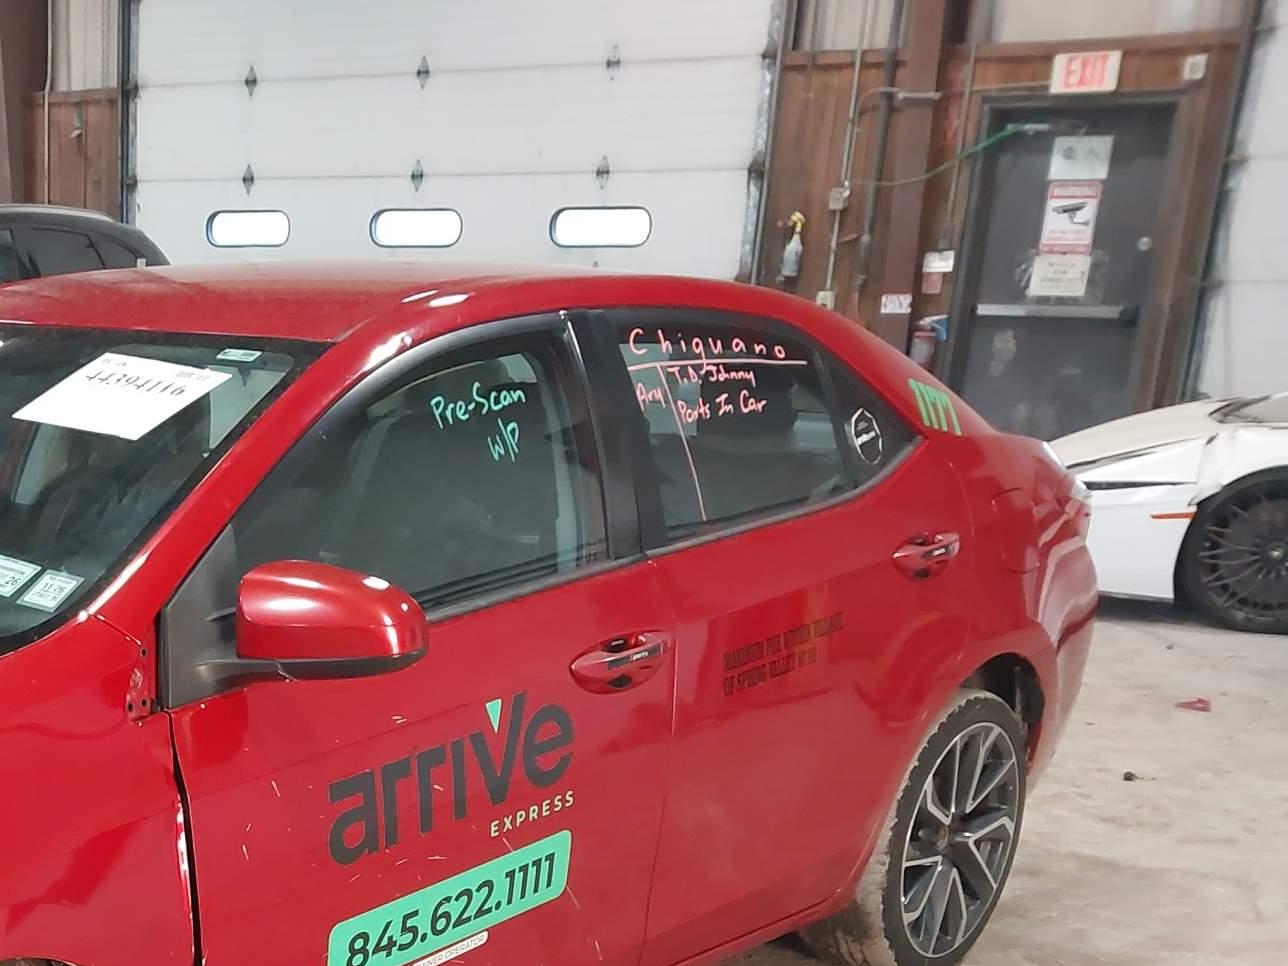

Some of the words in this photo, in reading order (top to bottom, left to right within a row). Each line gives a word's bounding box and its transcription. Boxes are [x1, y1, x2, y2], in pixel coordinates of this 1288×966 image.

[1063, 52, 1110, 90] EXIT
[85, 369, 186, 397] 44394116
[716, 393, 734, 415] In
[740, 389, 767, 414] Car
[490, 790, 575, 838] EXPRESS
[444, 934, 485, 959] OPERATOR
